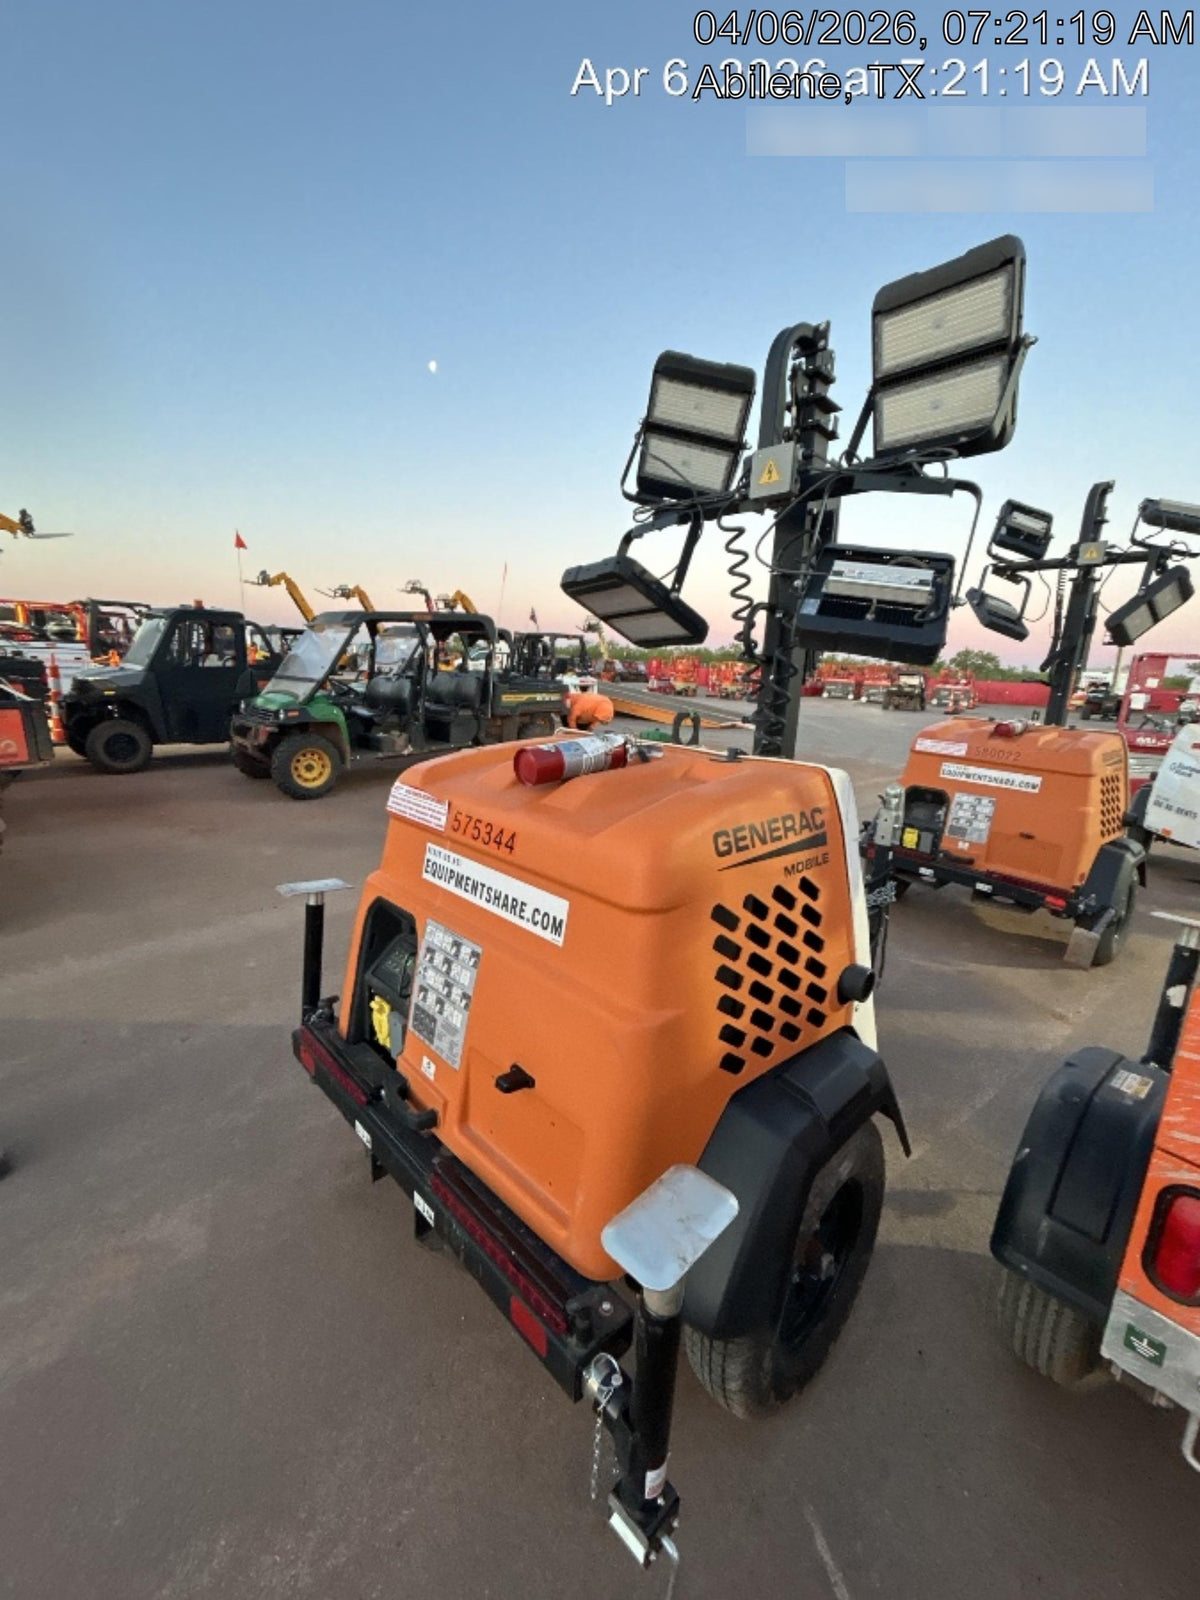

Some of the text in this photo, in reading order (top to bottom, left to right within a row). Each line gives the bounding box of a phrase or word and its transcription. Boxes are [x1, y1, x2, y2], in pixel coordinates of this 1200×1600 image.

[451, 811, 517, 855] 575344
[713, 807, 826, 858] GENERAC
[783, 852, 830, 878] MOBILE
[424, 858, 565, 937] EQUIPMENTSHARE.COM
